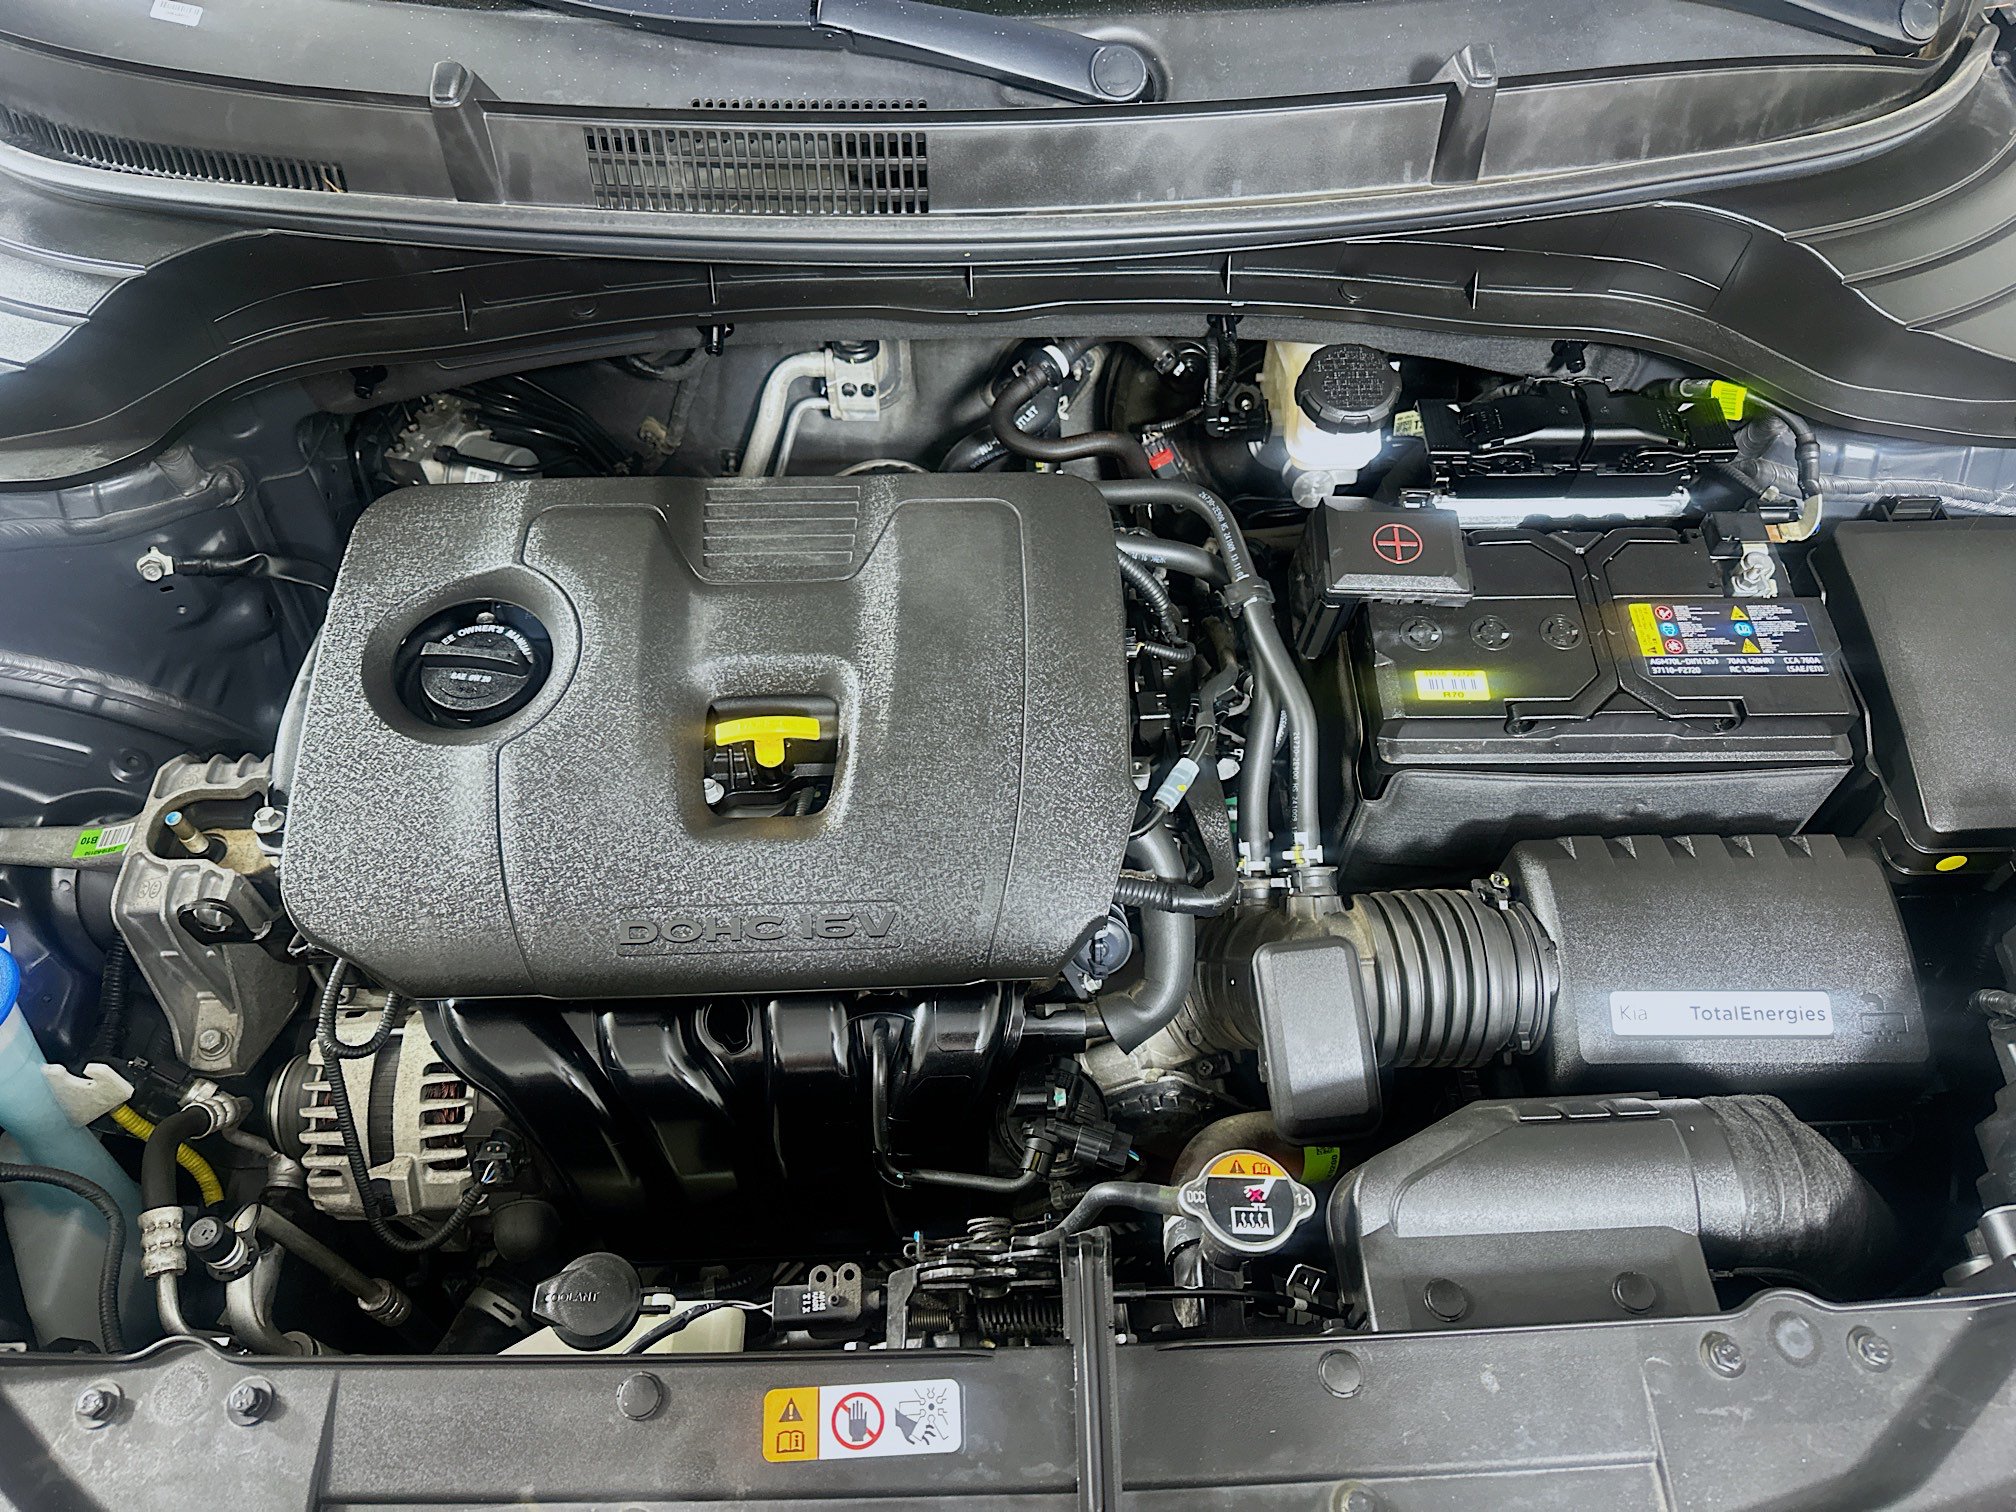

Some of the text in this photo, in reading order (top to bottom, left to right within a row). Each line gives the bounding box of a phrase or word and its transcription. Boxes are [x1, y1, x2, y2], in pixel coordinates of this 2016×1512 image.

[441, 624, 532, 656] EE OWNER'S MANUA
[1652, 666, 1701, 674] 37110-F2720
[80, 836, 98, 845] B10
[619, 913, 898, 945] DOHC 16V
[1620, 1005, 1826, 1024] Kia TotalEnergies
[1295, 1193, 1311, 1206] 1.1
